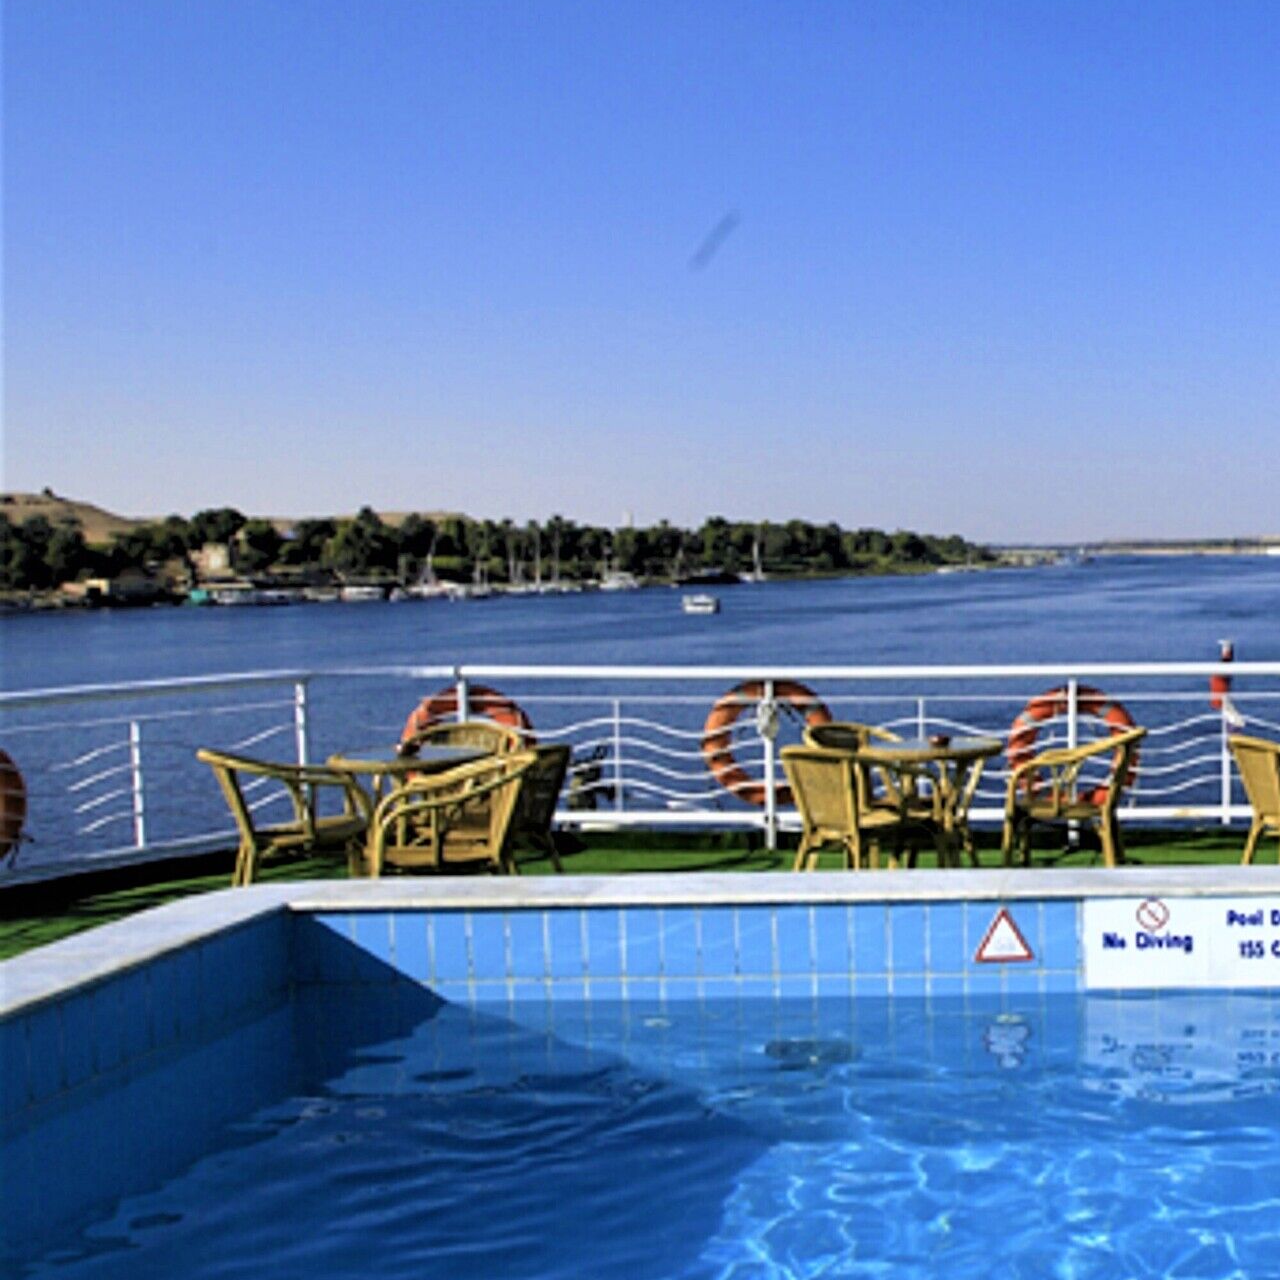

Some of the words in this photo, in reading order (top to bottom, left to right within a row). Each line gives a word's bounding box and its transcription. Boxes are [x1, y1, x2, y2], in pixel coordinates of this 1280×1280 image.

[1226, 910, 1263, 926] Pool
[1102, 933, 1126, 949] No
[1136, 931, 1193, 953] Diving
[1239, 940, 1264, 958] 155
